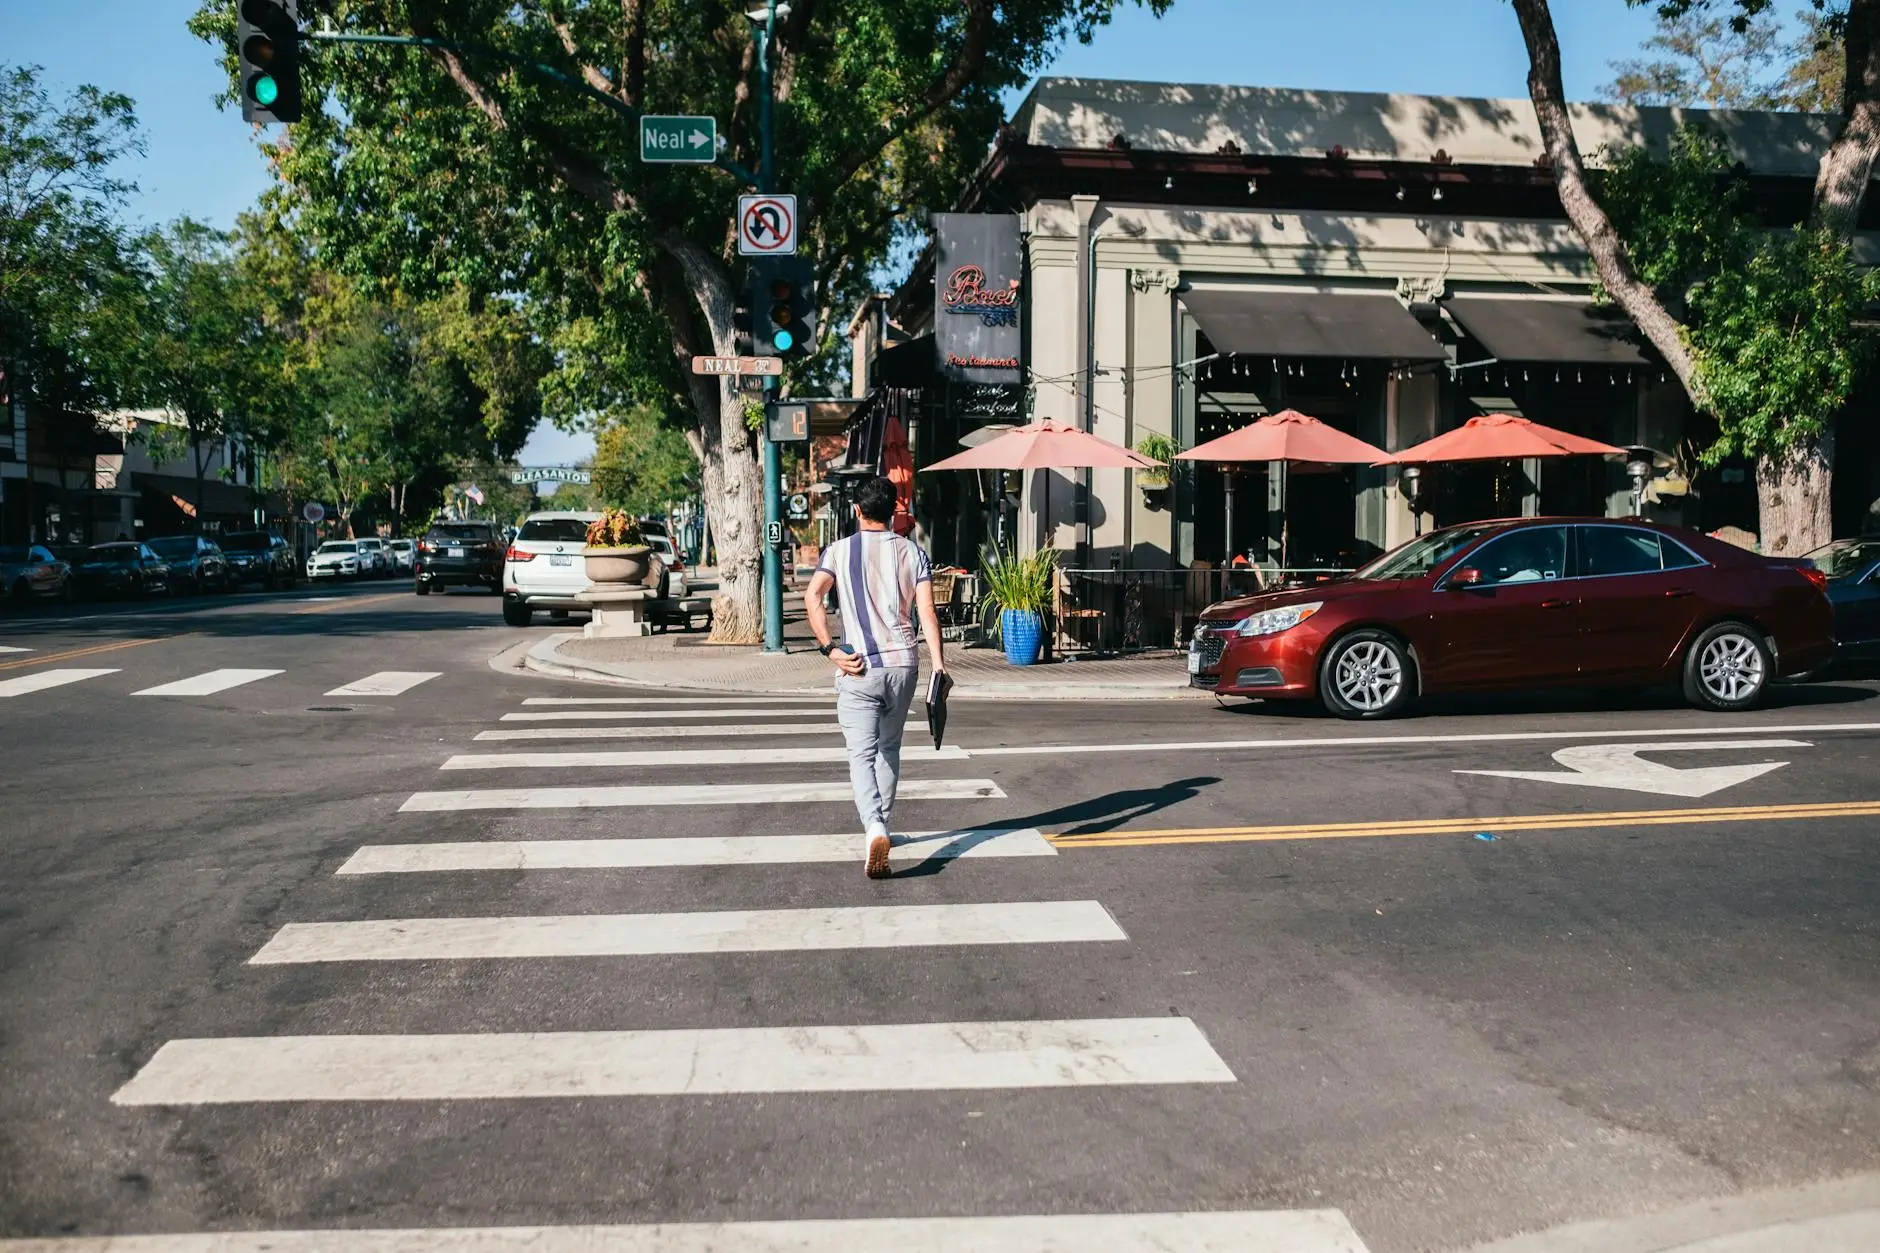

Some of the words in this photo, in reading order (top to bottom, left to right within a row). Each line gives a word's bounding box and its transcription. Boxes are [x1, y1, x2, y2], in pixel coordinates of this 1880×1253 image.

[645, 128, 685, 149] Neal
[943, 264, 1020, 306] Baci
[704, 359, 741, 372] NEAL
[792, 411, 806, 435] 12
[513, 468, 588, 482] PLEASANTON
